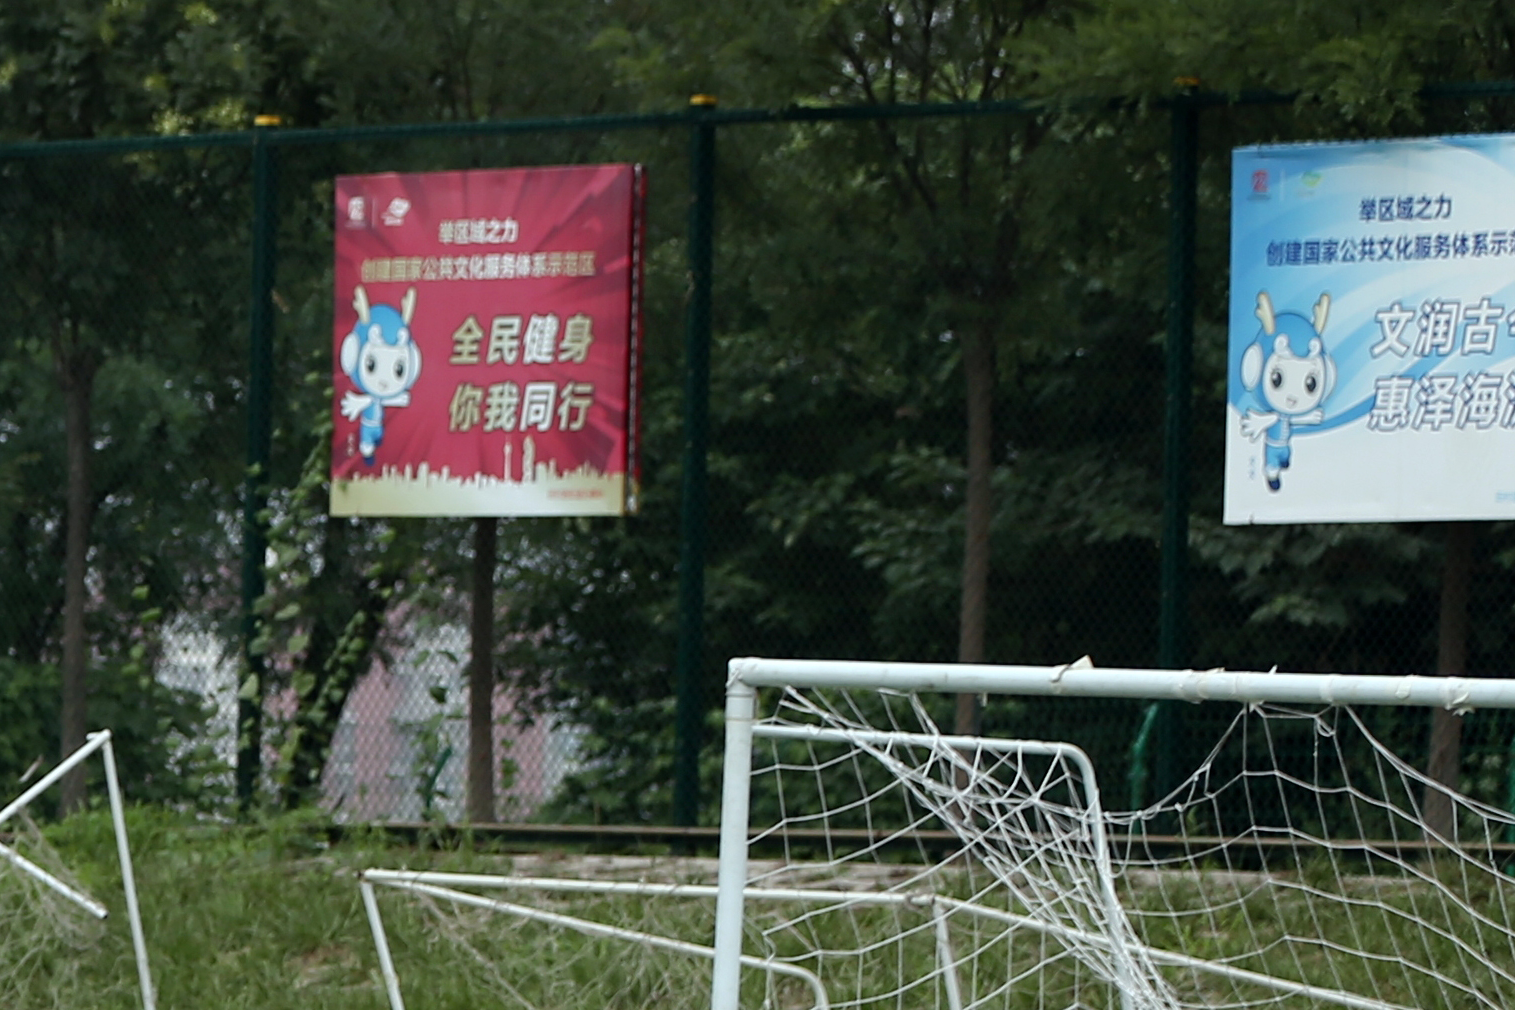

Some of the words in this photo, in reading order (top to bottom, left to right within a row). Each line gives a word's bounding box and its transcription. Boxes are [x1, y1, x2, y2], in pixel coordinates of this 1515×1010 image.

[1359, 193, 1452, 222] 举区域之力
[449, 313, 594, 365] 全民健身
[1369, 297, 1515, 359] 文润古
[449, 381, 593, 432] 你我同行
[1367, 372, 1515, 433] 惠泽海
